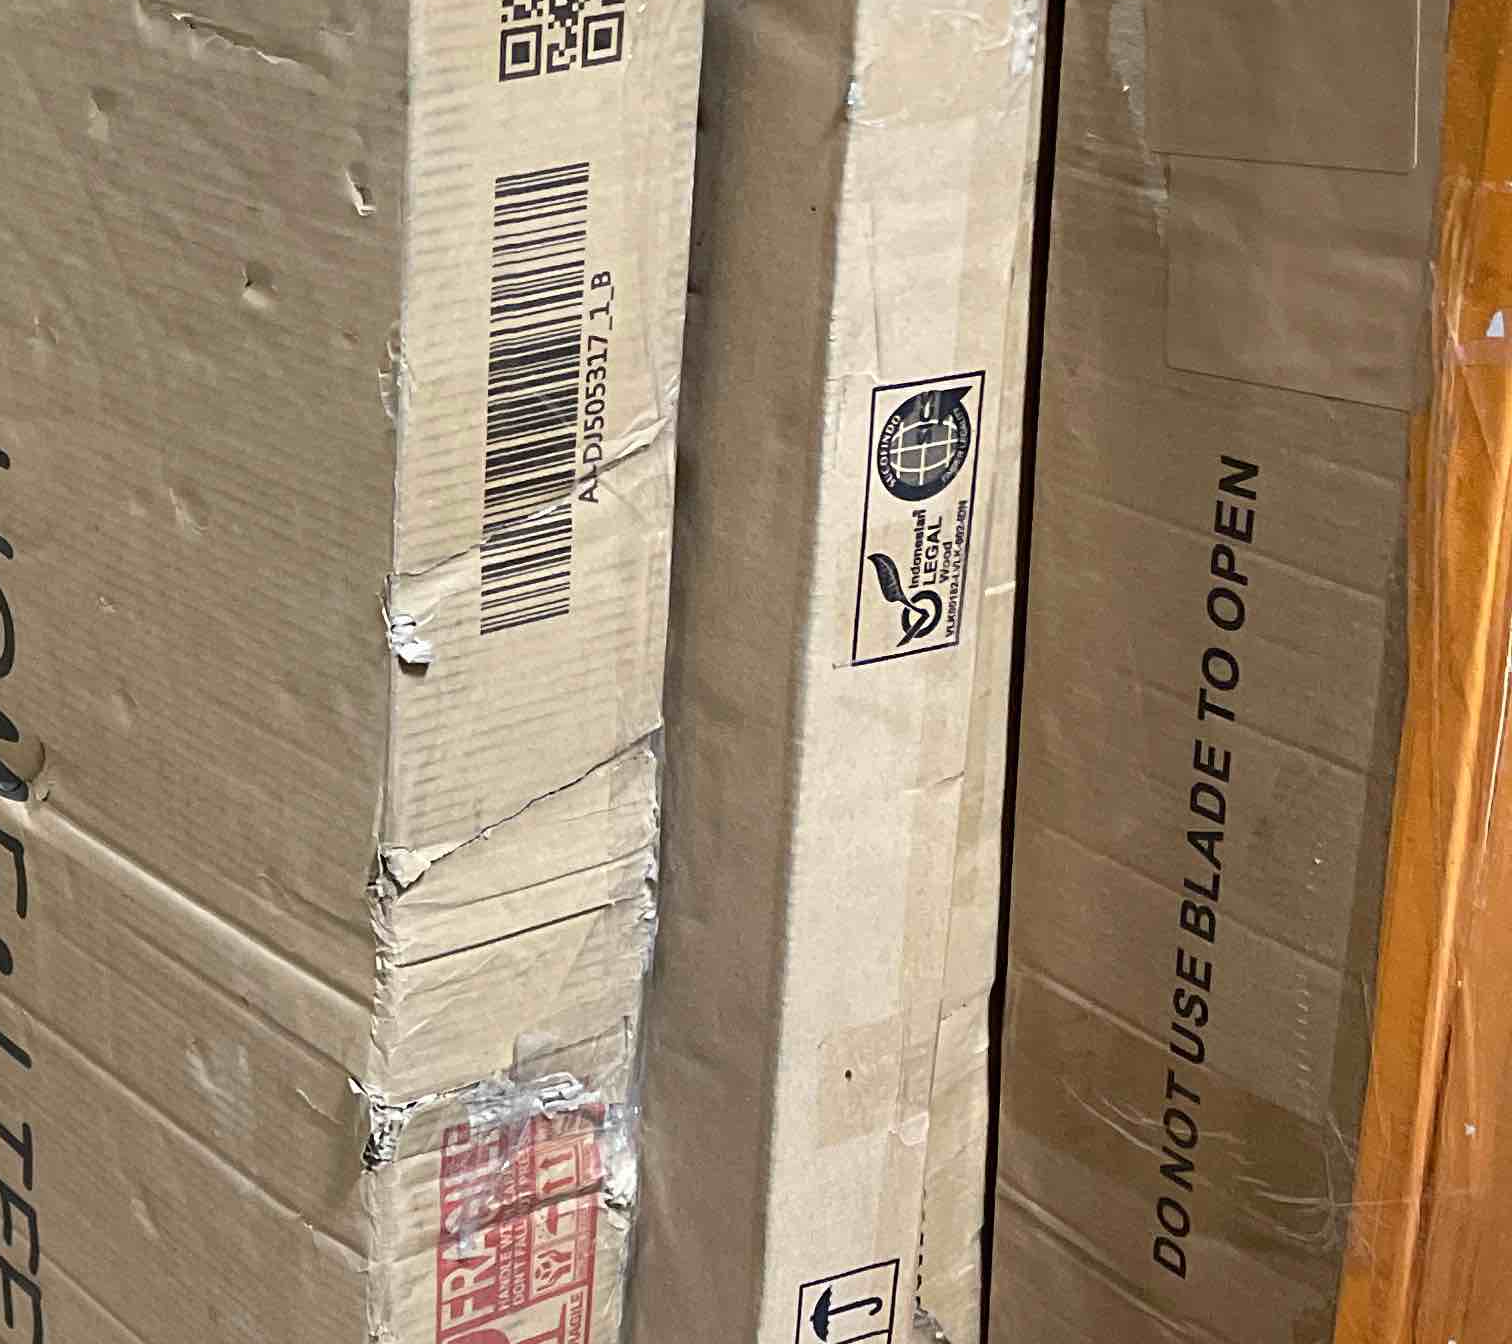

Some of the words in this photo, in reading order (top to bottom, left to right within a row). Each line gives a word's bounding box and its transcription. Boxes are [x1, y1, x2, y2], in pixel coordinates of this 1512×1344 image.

[909, 513, 926, 589] Indonesian
[923, 516, 943, 586] LEGAL
[939, 541, 953, 584] Wood
[1206, 455, 1261, 632] OPEN
[1197, 645, 1240, 723] TO
[1180, 738, 1232, 945] BLADE
[1170, 946, 1212, 1066] USE
[1160, 1071, 1202, 1191] NOT
[1152, 1196, 1191, 1279] DO
